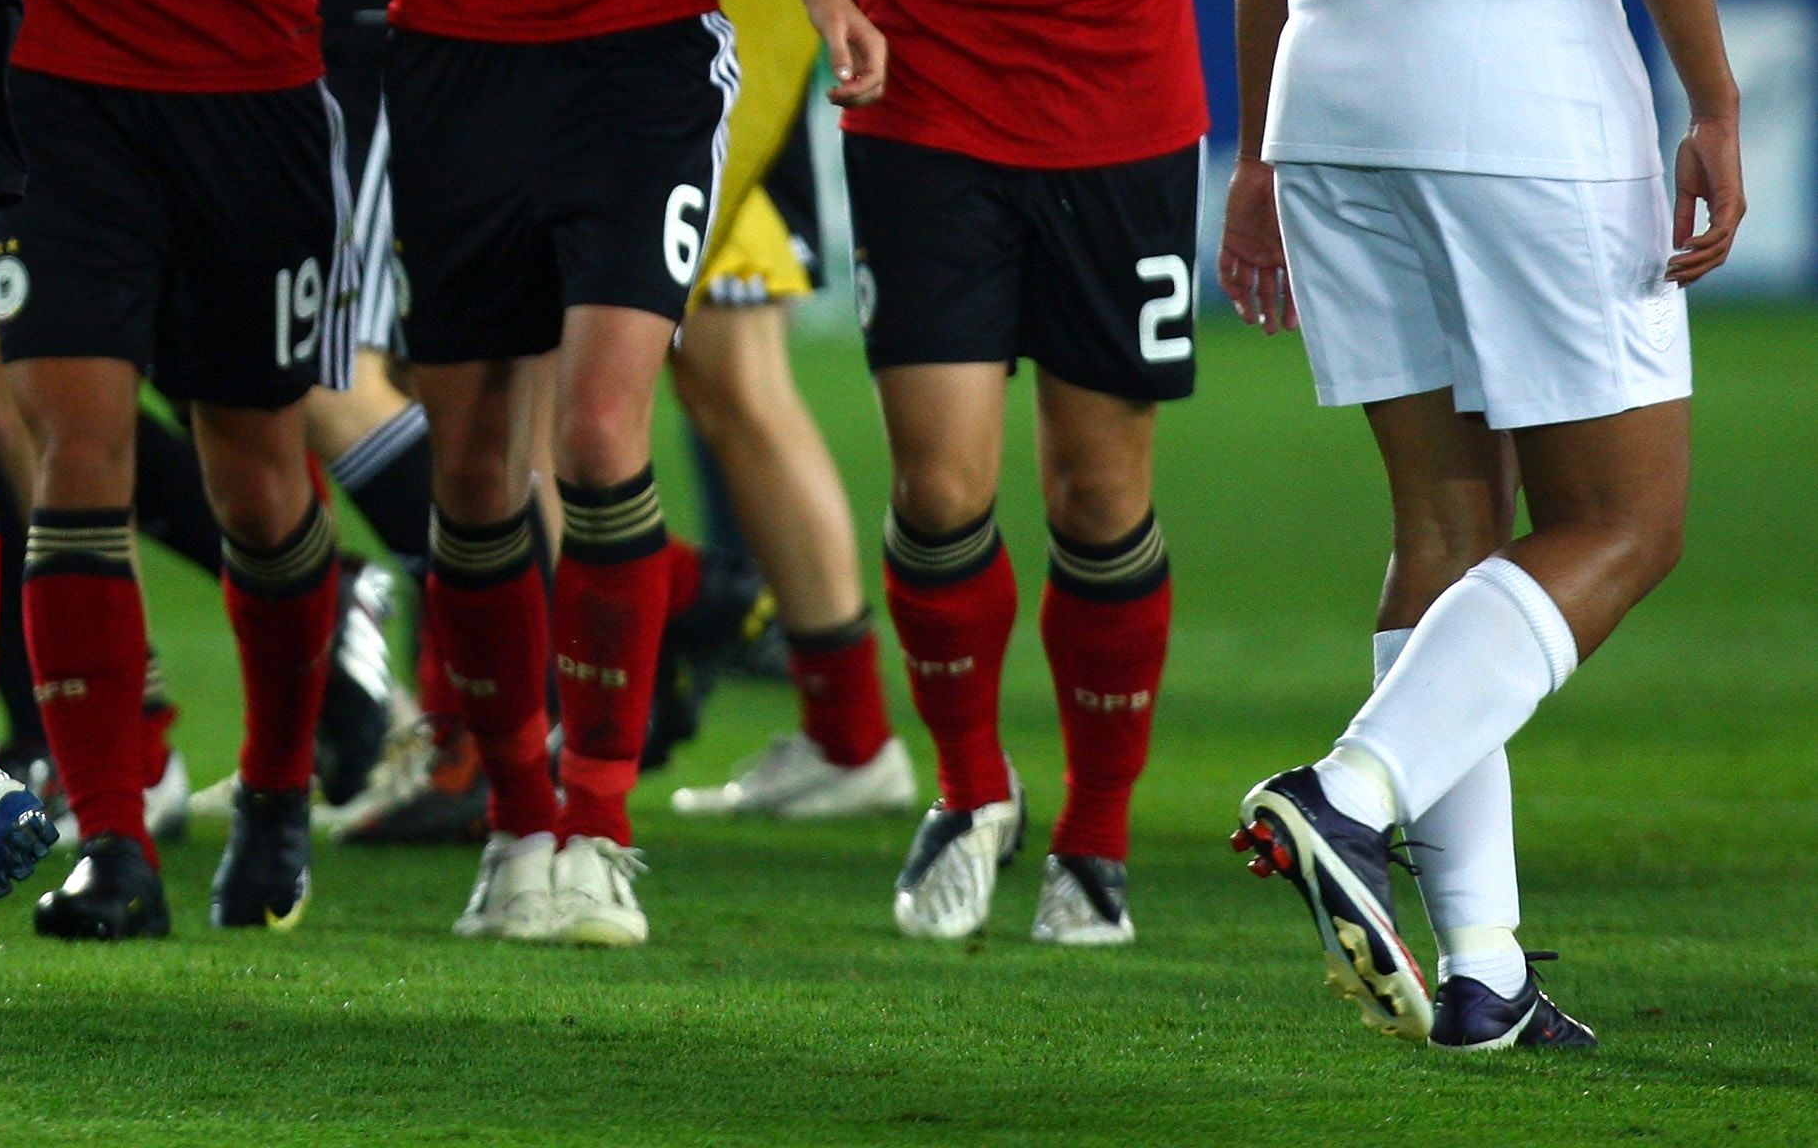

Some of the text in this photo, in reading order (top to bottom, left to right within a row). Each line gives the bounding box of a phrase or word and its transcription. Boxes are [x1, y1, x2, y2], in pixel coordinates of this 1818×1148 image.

[663, 183, 705, 286] 6
[275, 256, 322, 367] 19
[1135, 254, 1192, 363] 2
